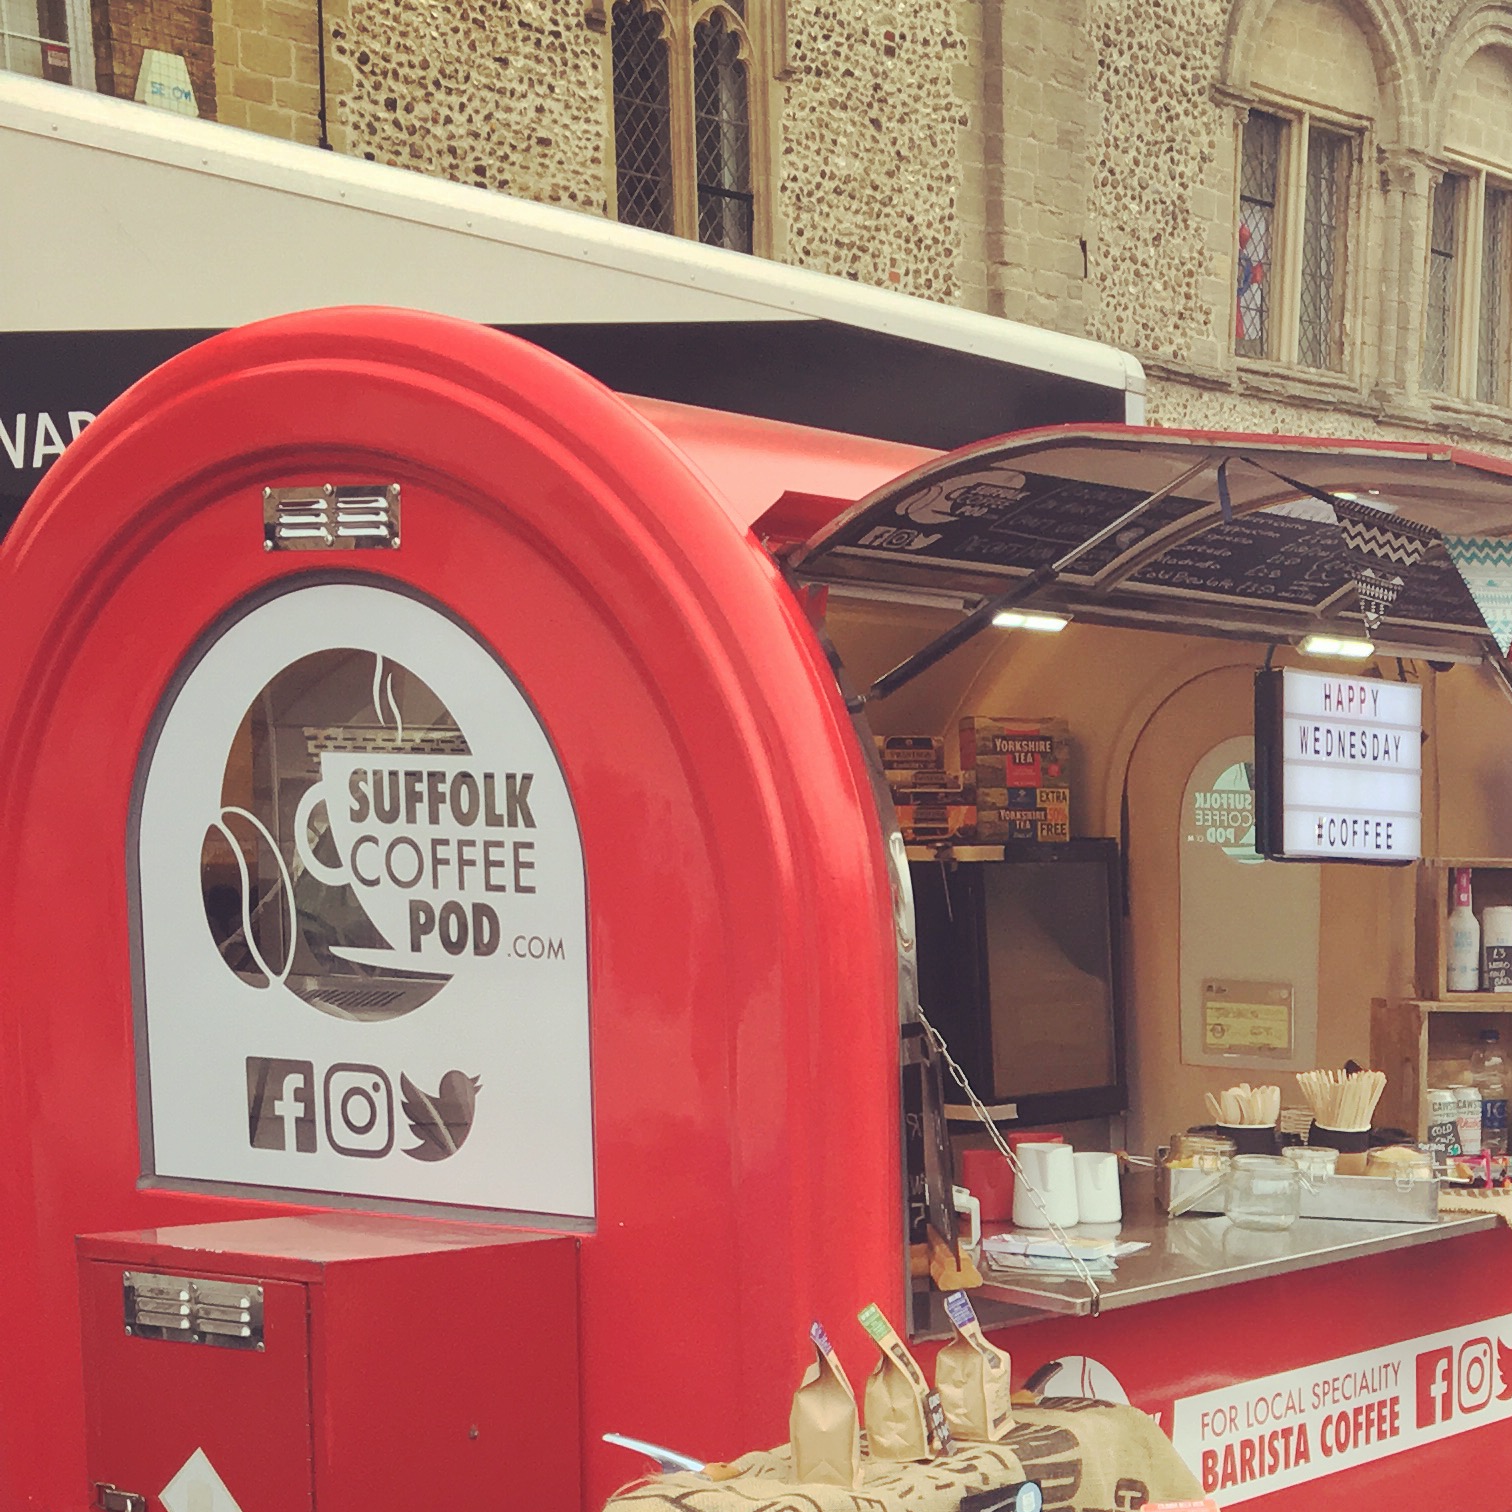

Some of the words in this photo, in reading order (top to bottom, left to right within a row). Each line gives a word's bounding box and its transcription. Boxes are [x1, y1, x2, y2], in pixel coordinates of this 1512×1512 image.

[1323, 683, 1379, 717] HAPPY
[995, 738, 1051, 752] YORKSHIRE
[1014, 753, 1033, 764] TEA
[1299, 725, 1401, 762] WEDNESDAY
[349, 768, 537, 829] SUFFOLK
[1039, 790, 1067, 803] EXTRA
[1015, 820, 1031, 829] TEA
[1040, 823, 1067, 836] FREE
[1316, 816, 1393, 850] #COFFEE
[350, 834, 537, 894] COFFEE
[408, 899, 501, 957] POD
[1201, 1404, 1240, 1441] FOR
[1246, 1387, 1306, 1430] LOCAL
[1311, 1360, 1402, 1411] SPECIALITY
[1202, 1422, 1312, 1495] BARISTA
[1320, 1395, 1400, 1458] COFFEE
